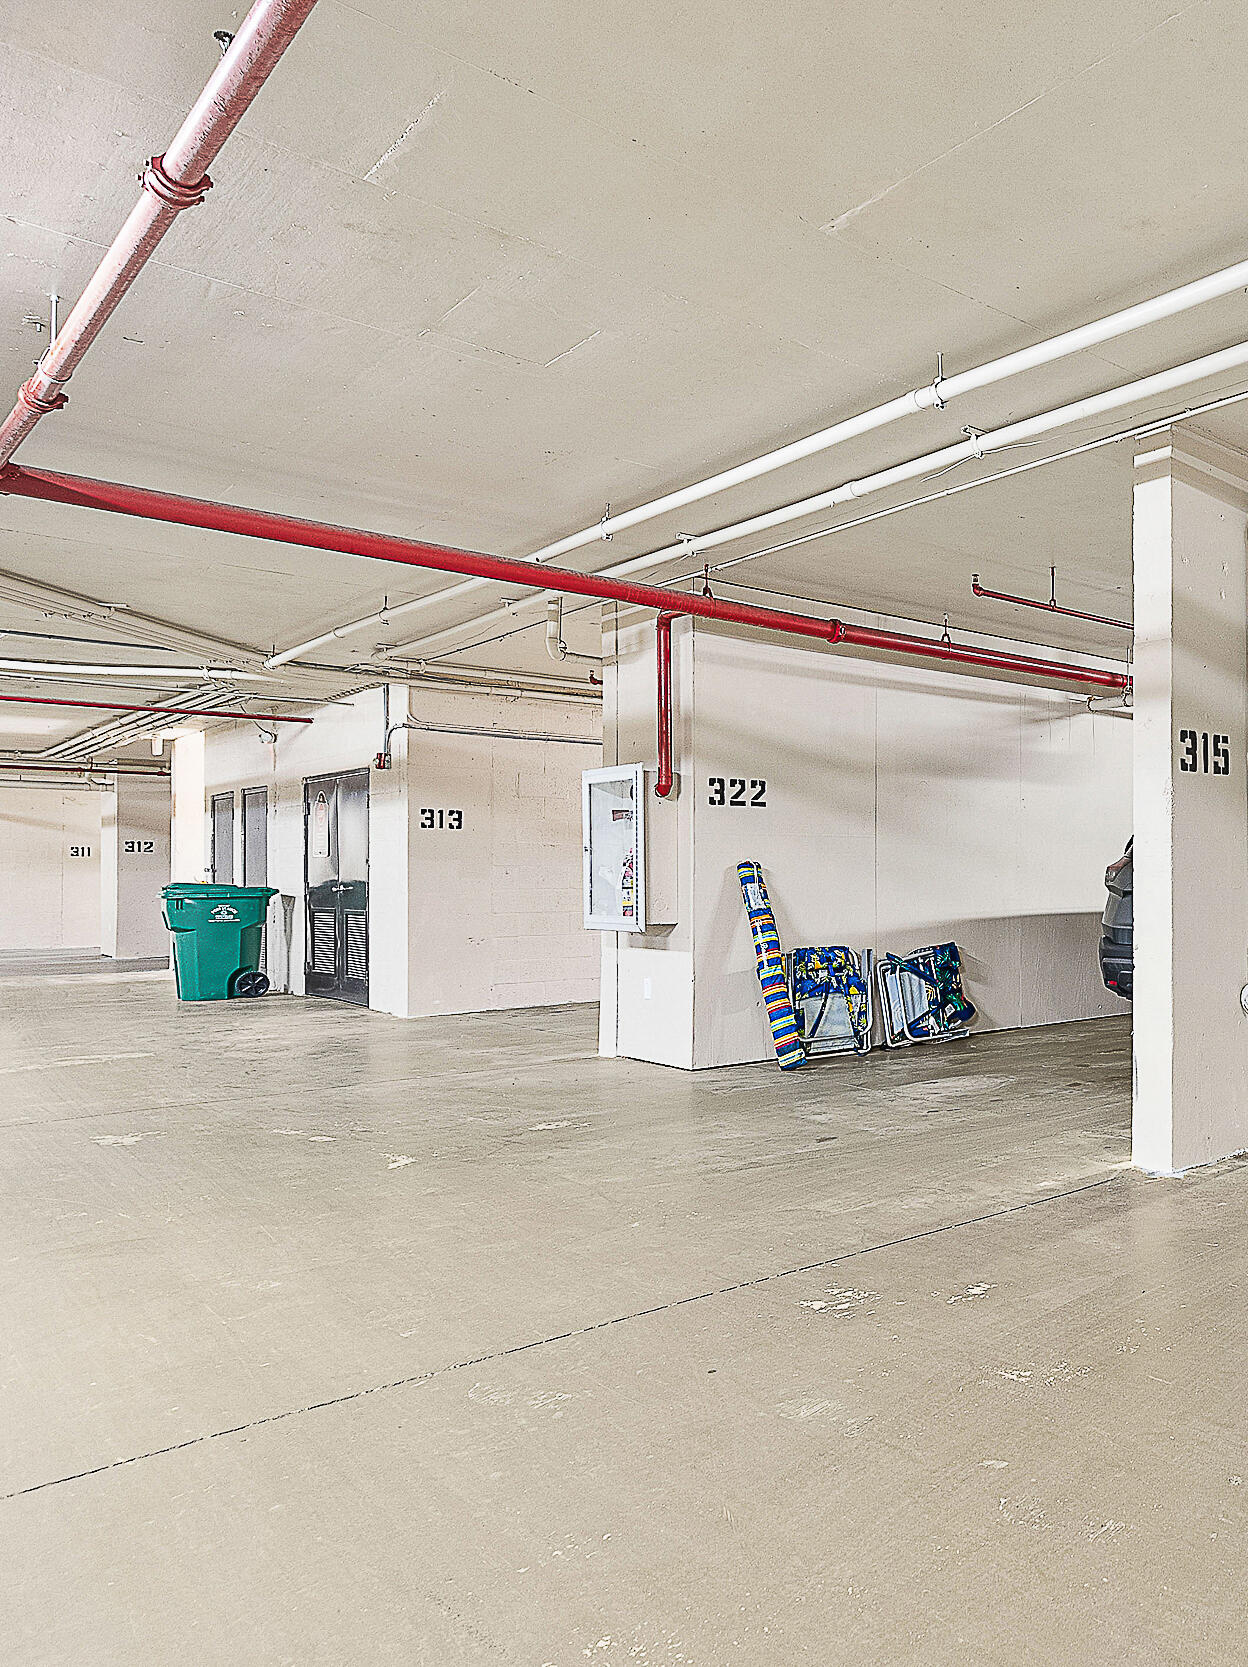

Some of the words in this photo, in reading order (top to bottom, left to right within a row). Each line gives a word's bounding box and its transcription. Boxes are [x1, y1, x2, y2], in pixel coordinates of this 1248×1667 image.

[1180, 729, 1230, 775] 315
[708, 777, 767, 808] 322
[420, 808, 463, 830] 313
[70, 846, 91, 858] 311
[125, 840, 154, 853] 312
